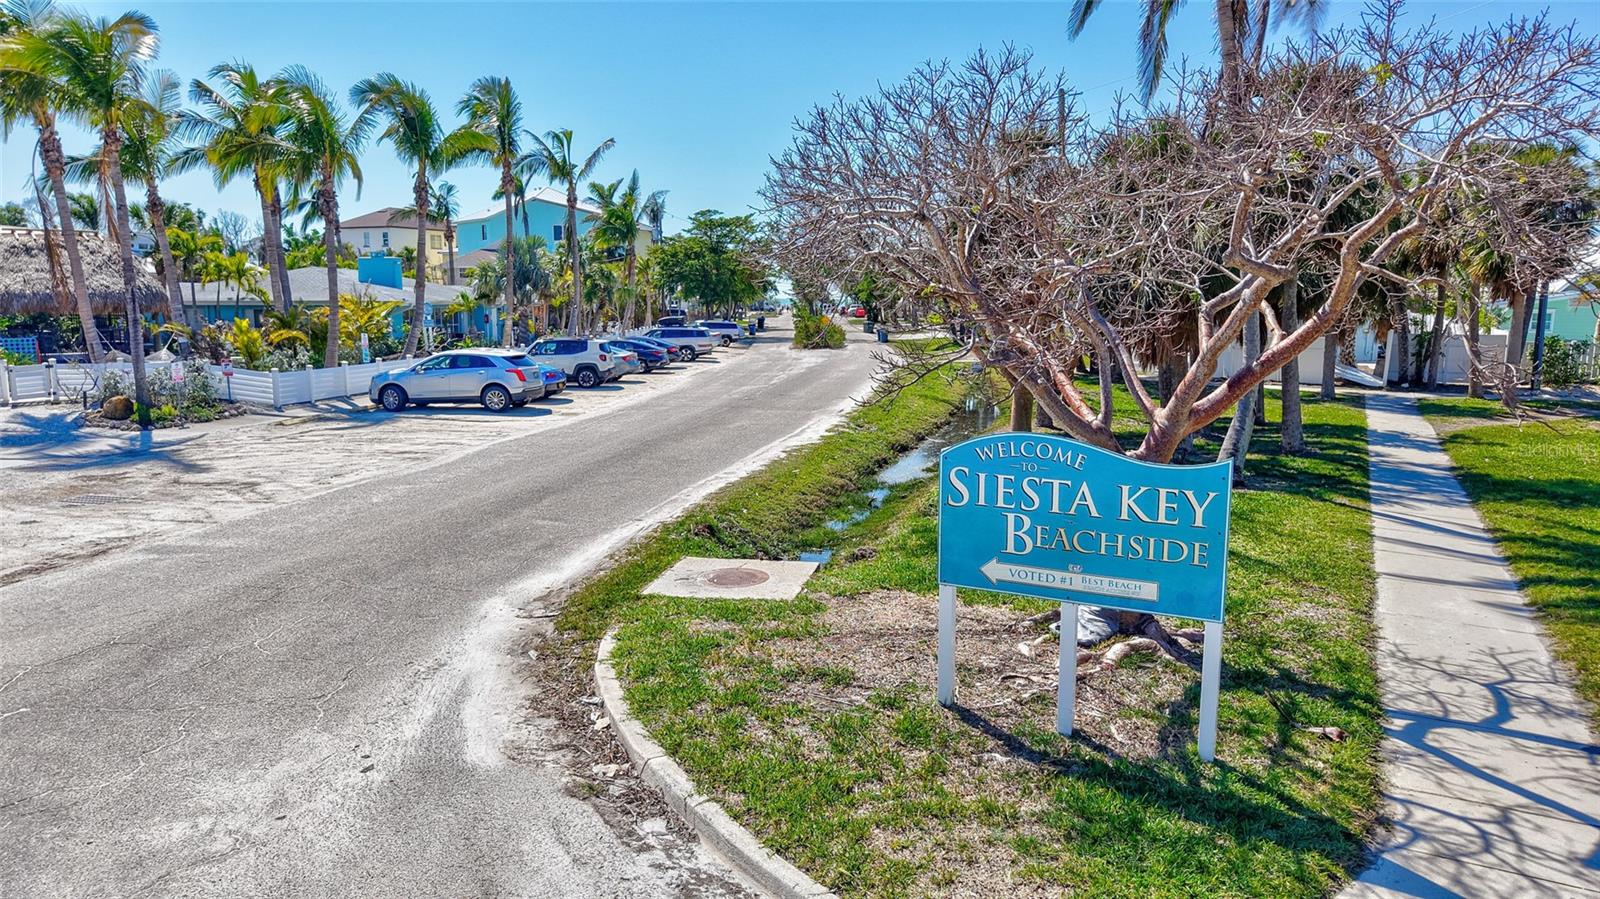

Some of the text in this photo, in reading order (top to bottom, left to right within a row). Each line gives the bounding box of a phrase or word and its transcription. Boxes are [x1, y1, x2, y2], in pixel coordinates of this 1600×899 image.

[975, 441, 1088, 471] WELCOME
[1021, 462, 1037, 472] TO
[946, 466, 1220, 529] SIESTA KEY
[1000, 512, 1209, 569] BEACHSIDE
[1008, 568, 1073, 586] VOTED #1
[1081, 576, 1104, 585] BEST
[1108, 580, 1142, 591] BEACH
